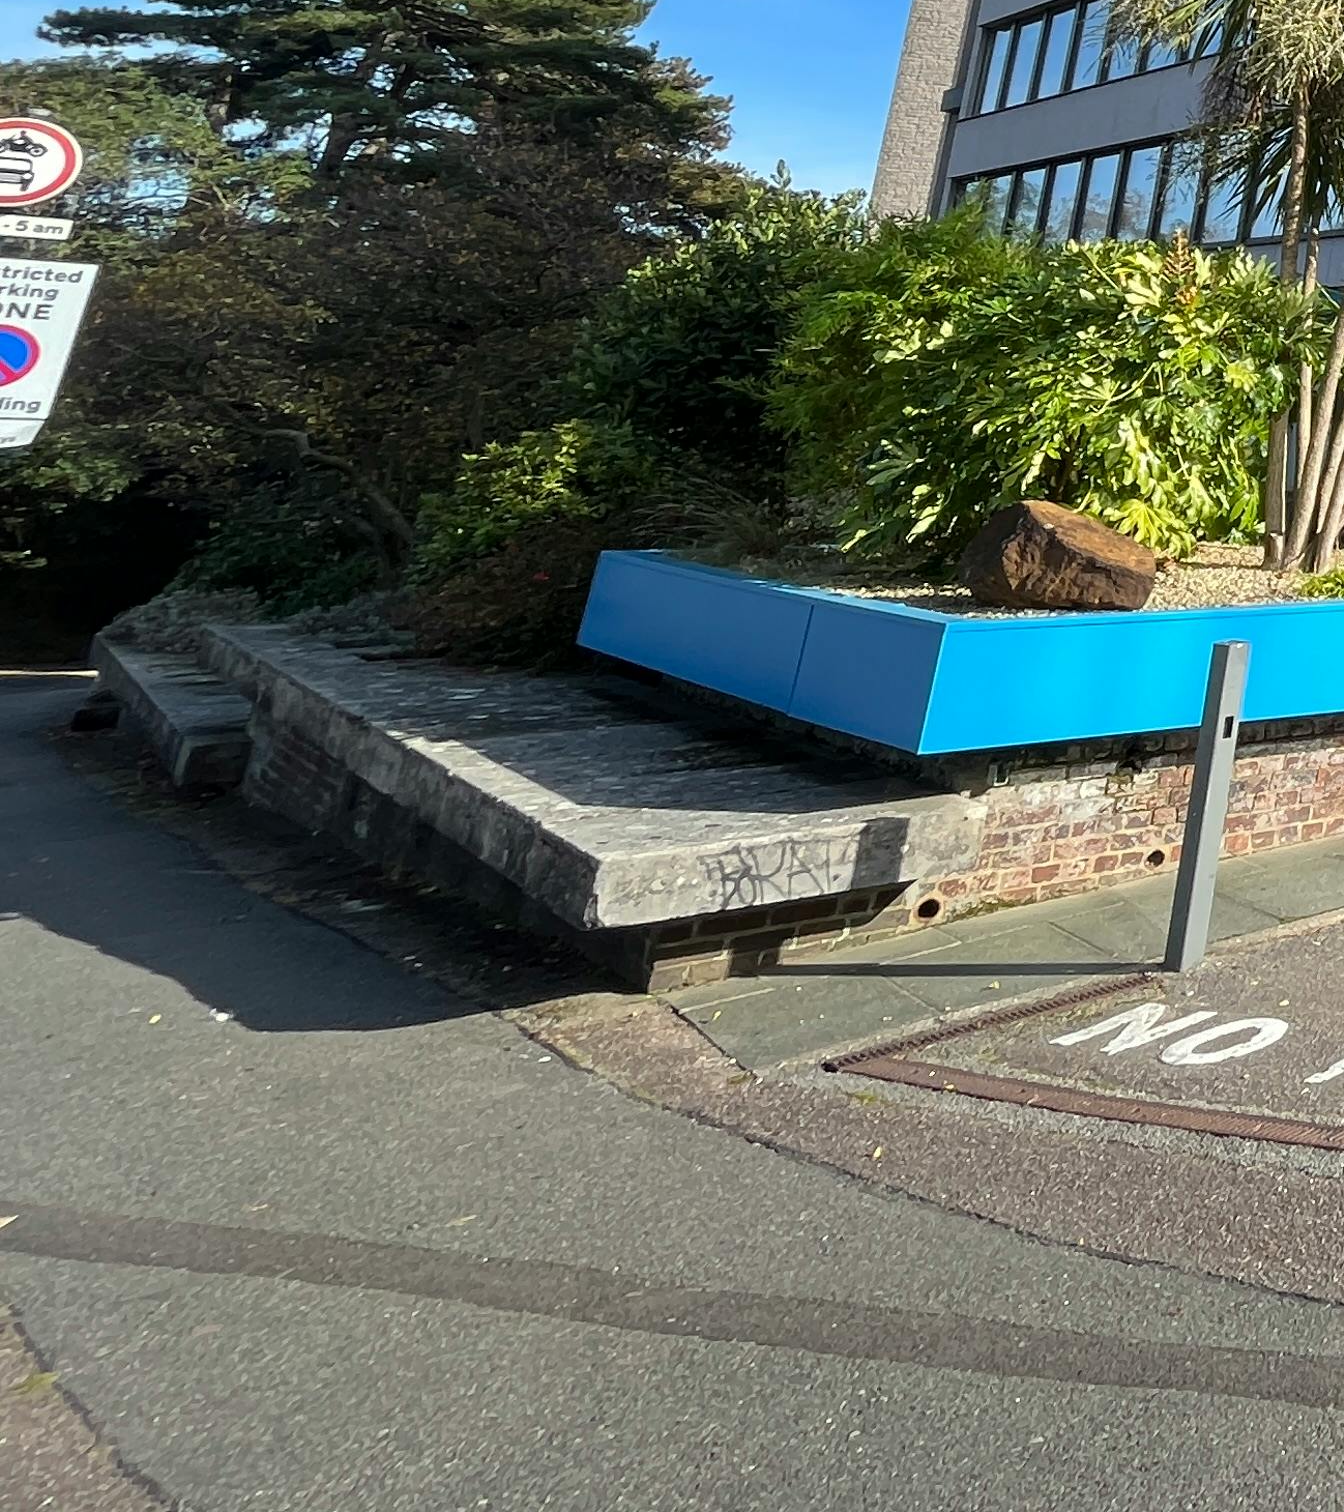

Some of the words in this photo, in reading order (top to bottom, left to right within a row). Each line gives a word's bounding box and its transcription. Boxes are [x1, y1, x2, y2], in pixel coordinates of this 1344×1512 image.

[15, 220, 29, 232] 5
[33, 224, 63, 235] am
[1048, 1002, 1289, 1066] NO
